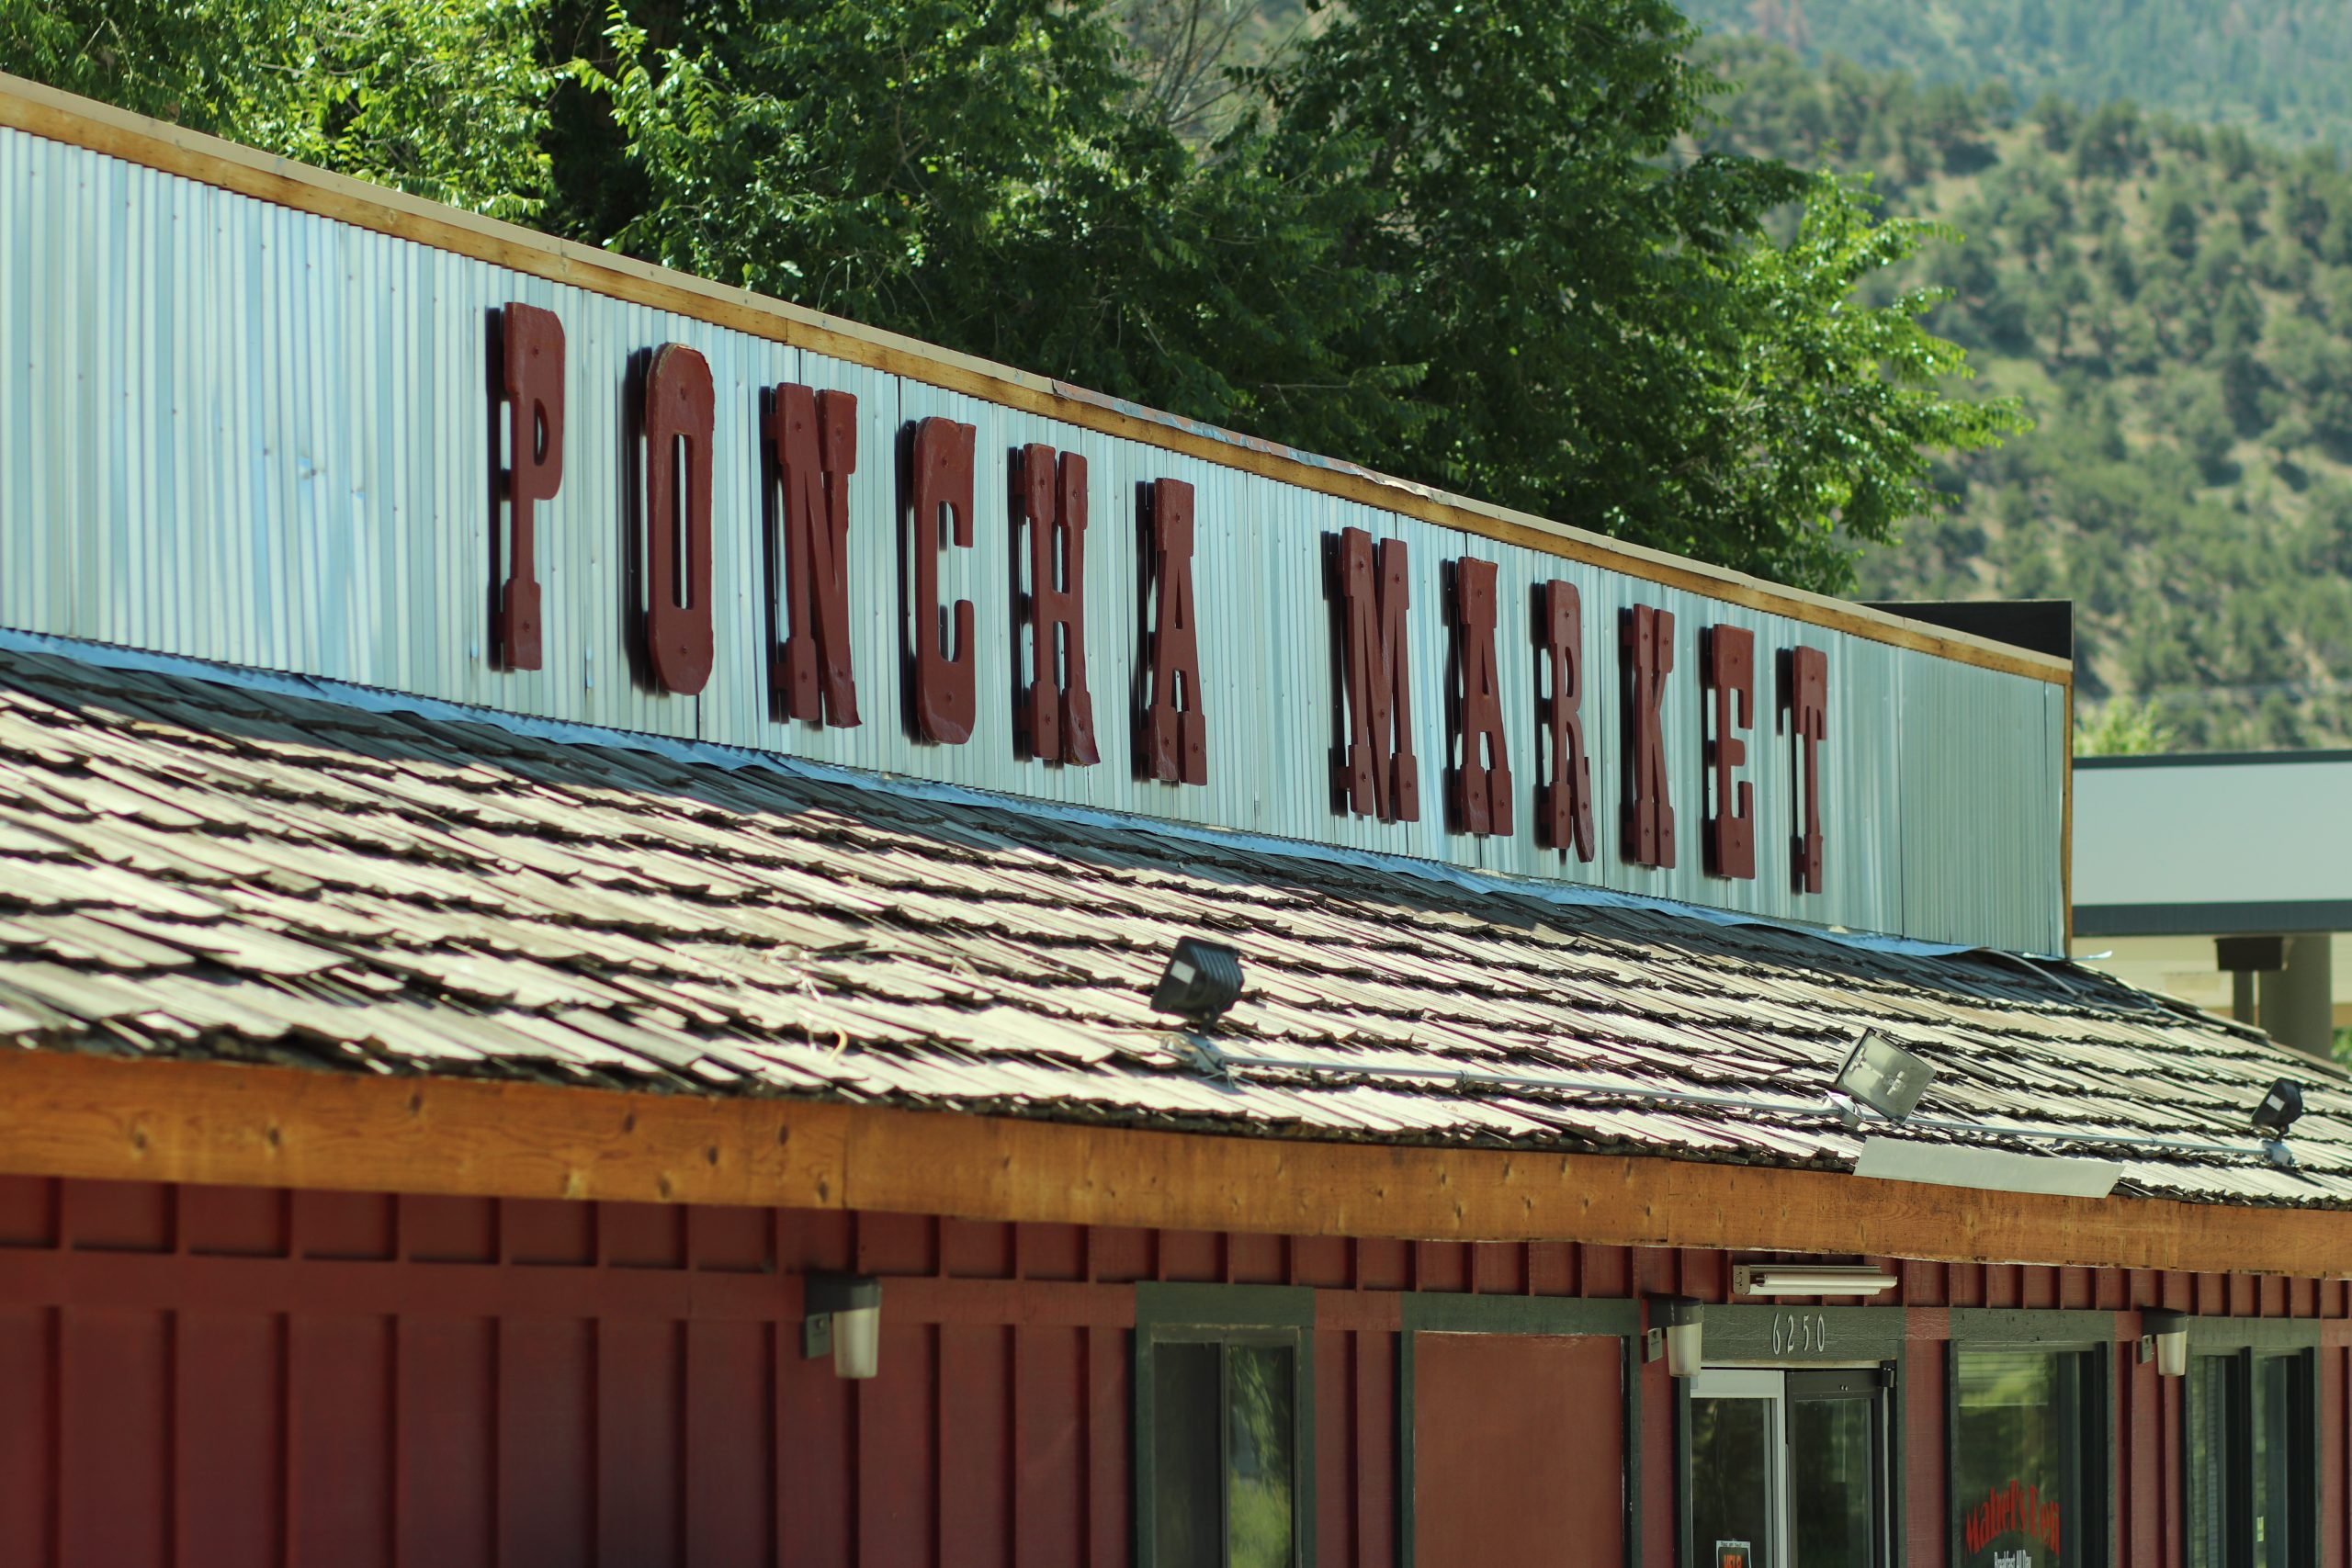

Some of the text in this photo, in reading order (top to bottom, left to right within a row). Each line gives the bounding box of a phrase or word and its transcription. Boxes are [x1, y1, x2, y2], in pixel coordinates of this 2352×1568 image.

[503, 301, 1828, 894] PONCHA MARKET
[1772, 1313, 1825, 1355] 6250
